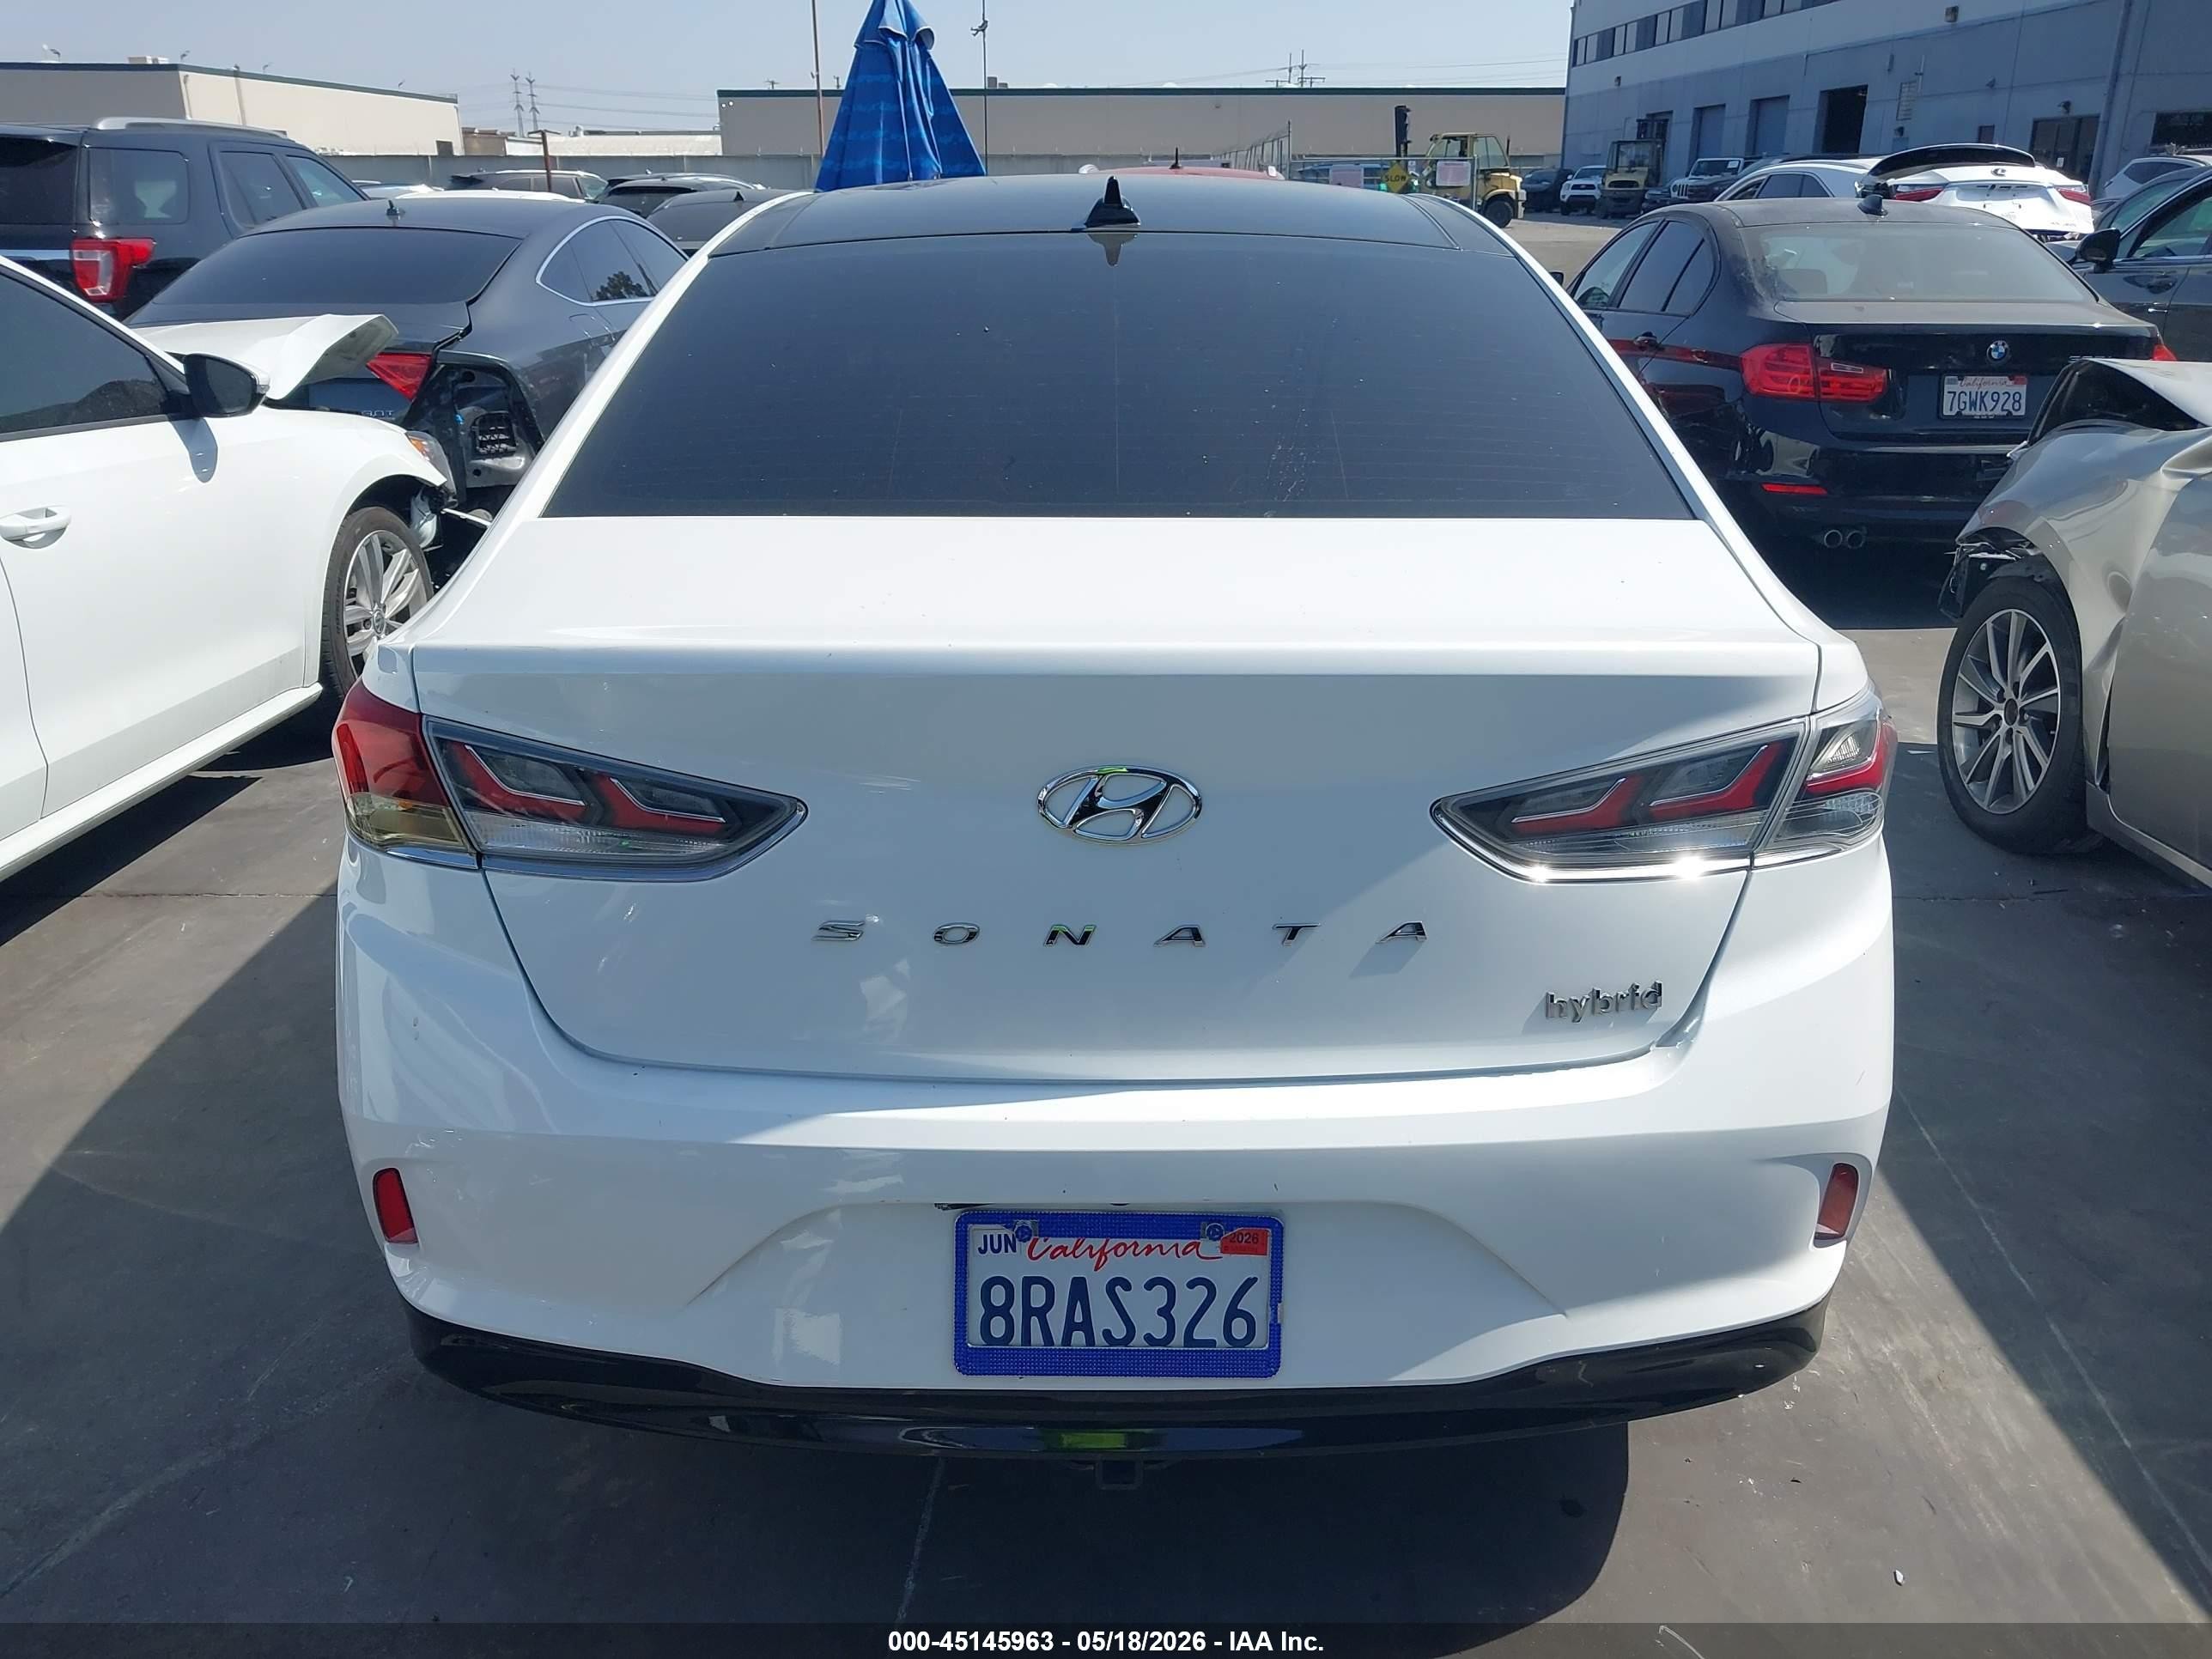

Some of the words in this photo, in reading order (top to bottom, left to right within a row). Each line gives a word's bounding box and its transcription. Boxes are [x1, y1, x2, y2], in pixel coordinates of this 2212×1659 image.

[1947, 390, 2022, 413] 7GWK928
[813, 920, 1428, 947] SONATA
[1546, 981, 1662, 1023] hybrid
[977, 1233, 1017, 1255] JUN
[1229, 1231, 1259, 1244] 2026
[1026, 1237, 1224, 1272] California
[979, 1275, 1259, 1348] 8RAS326
